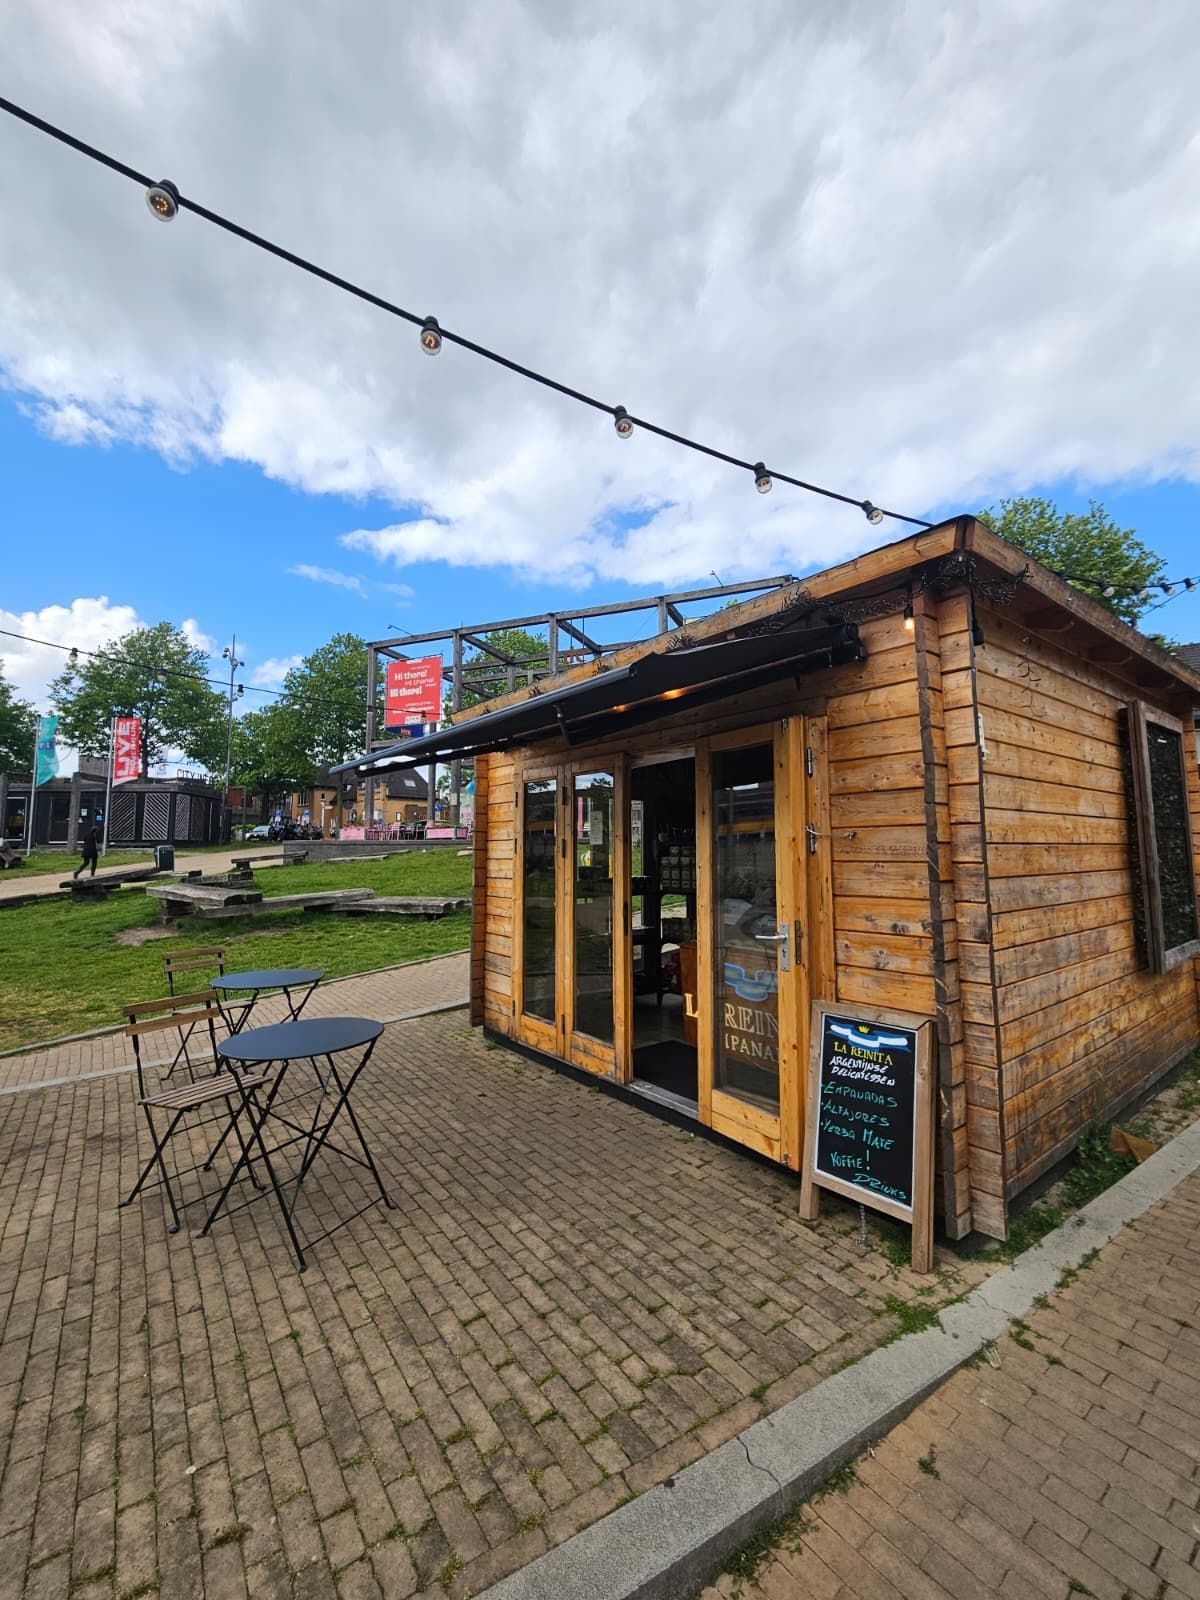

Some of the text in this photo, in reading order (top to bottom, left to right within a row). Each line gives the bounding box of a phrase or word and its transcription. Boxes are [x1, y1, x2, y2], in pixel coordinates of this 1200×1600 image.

[684, 992, 779, 1038] L REIN
[833, 1041, 894, 1066] LA REINITA
[823, 1081, 898, 1107] EMPANADAS
[823, 1098, 890, 1126] ALFAJORES
[863, 1128, 895, 1150] MATE
